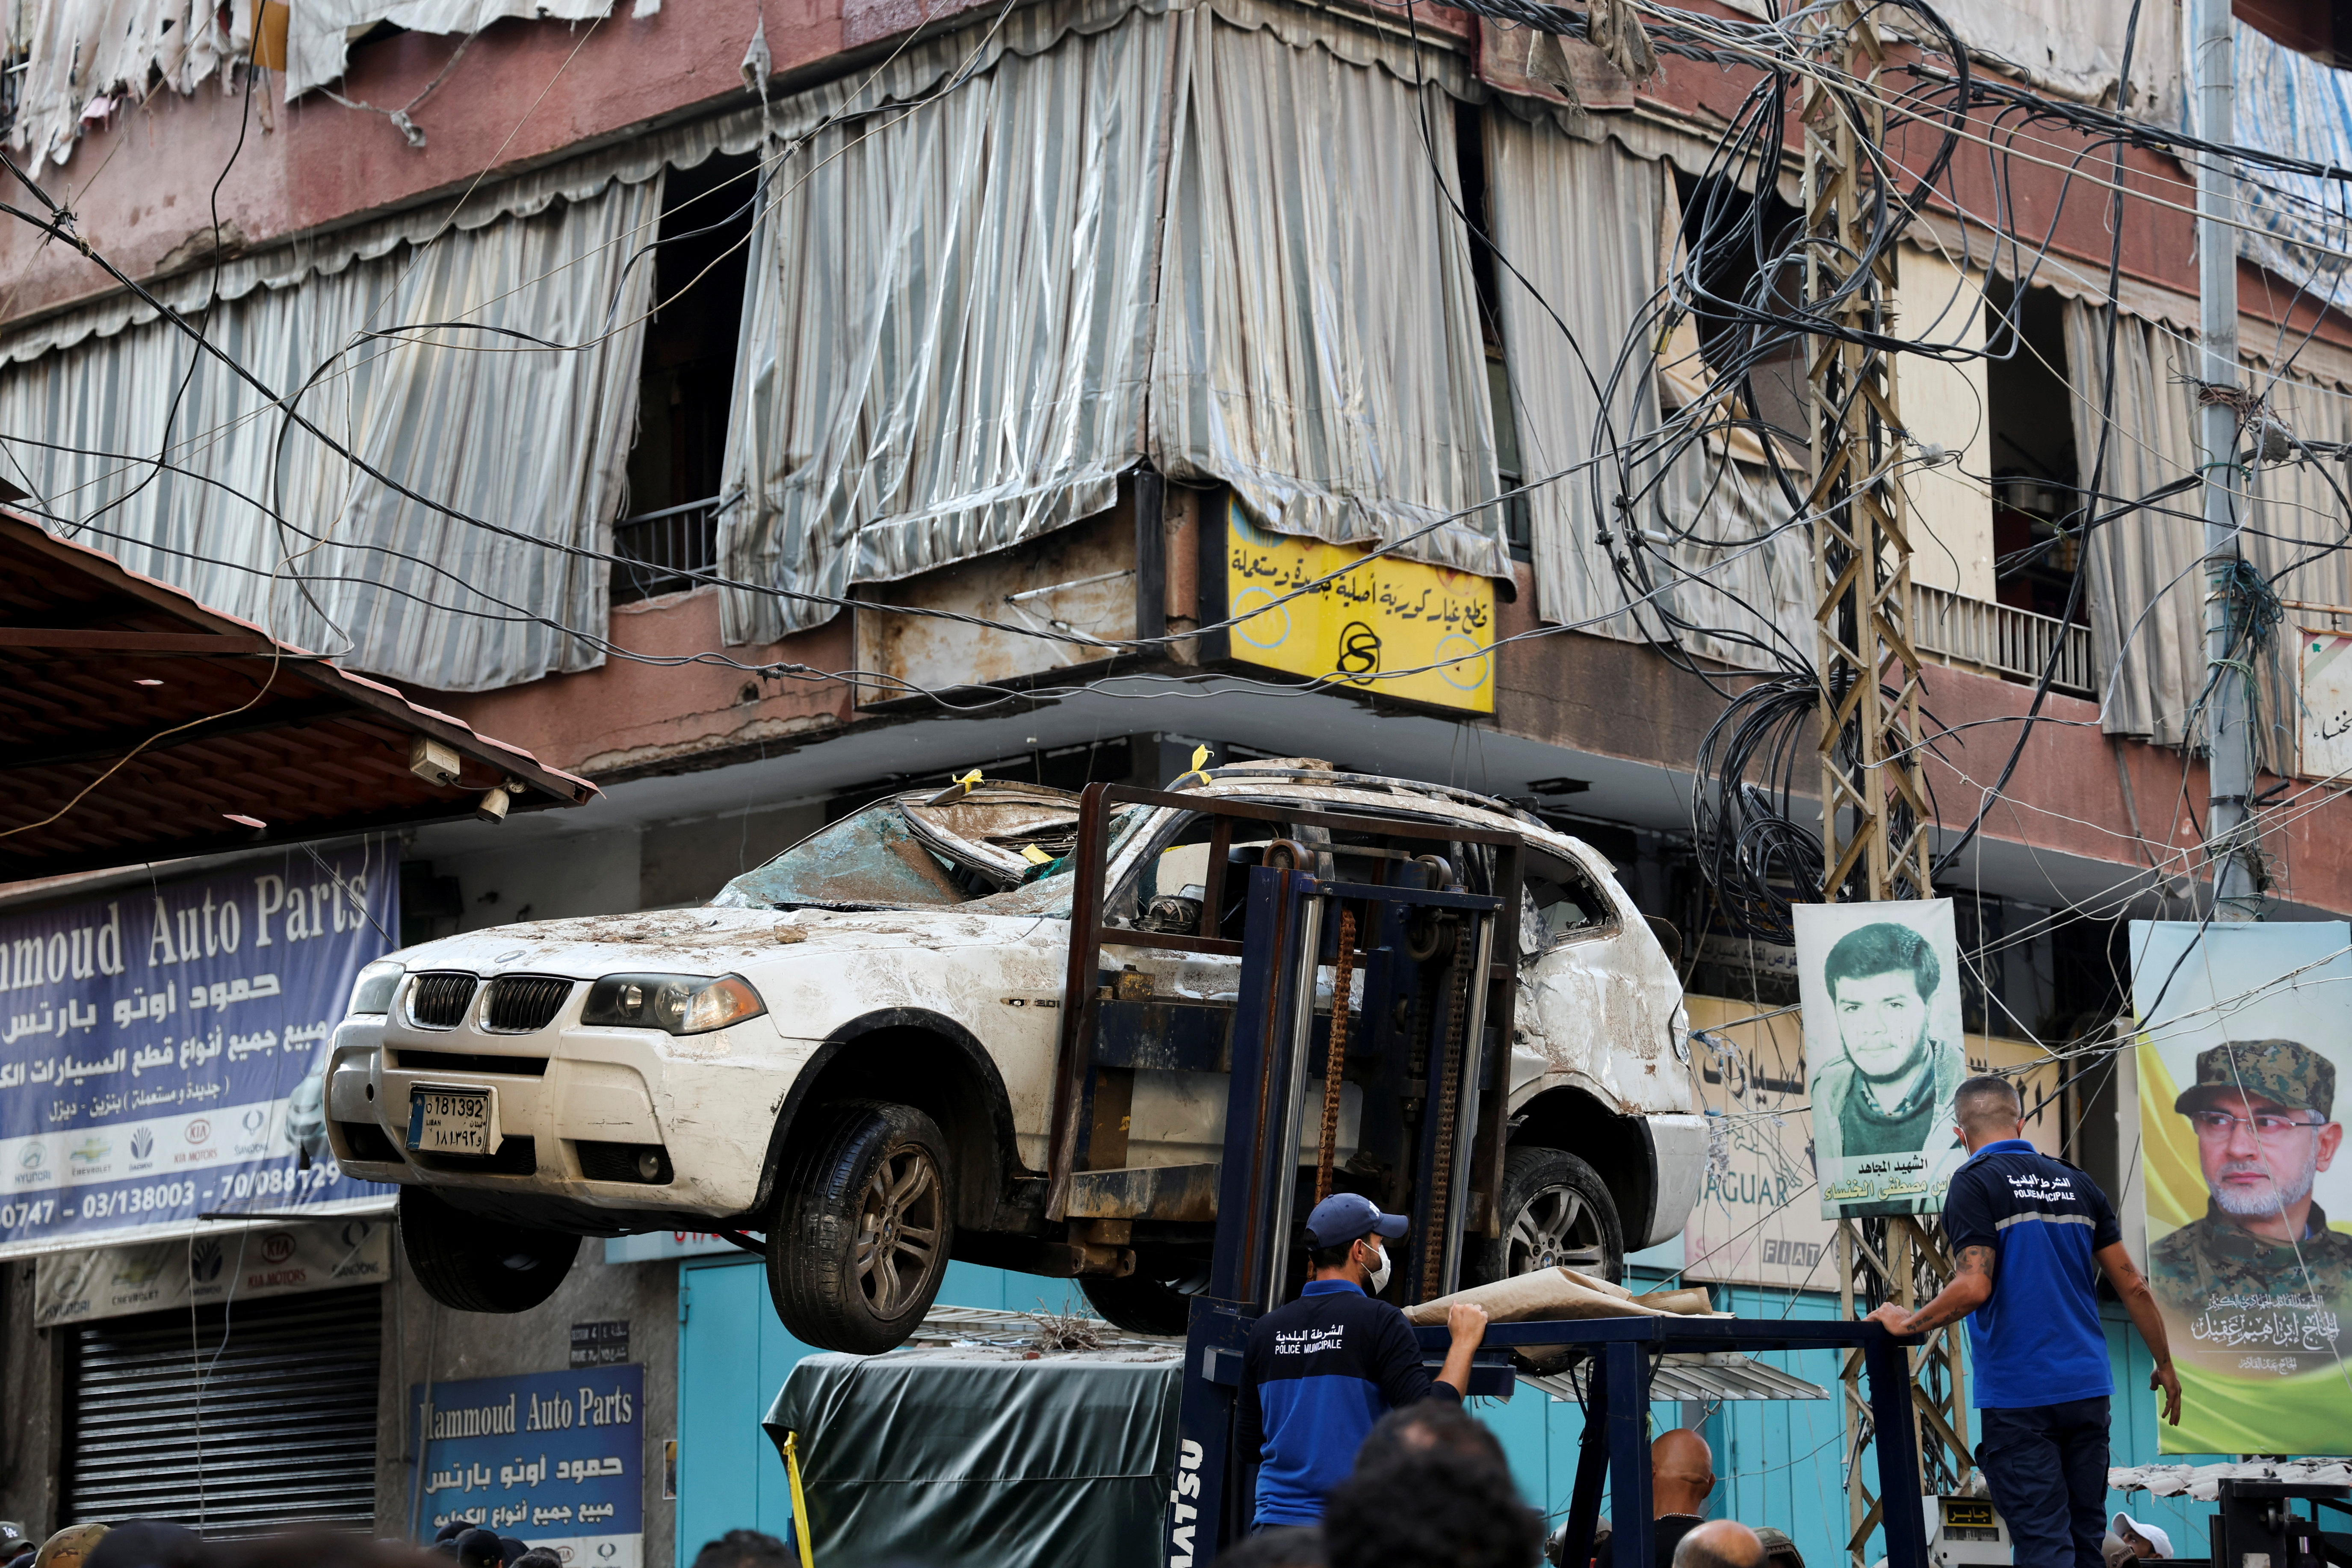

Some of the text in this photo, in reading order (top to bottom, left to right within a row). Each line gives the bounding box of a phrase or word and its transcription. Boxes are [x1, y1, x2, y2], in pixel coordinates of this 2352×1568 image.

[1336, 573, 1375, 607] أصلية
[1380, 584, 1432, 619] كورية
[1427, 598, 1460, 631] غيار
[1462, 598, 1487, 634] قطع
[0, 861, 367, 992] moud Auto Parts
[1, 973, 281, 1045] حمود أوتو بارتس
[179, 1024, 223, 1070] أنواع
[228, 1029, 278, 1063] جميع
[283, 1020, 327, 1053] مبيع
[30, 1047, 127, 1087] السيارات
[131, 1036, 174, 1078] قطع
[49, 1099, 78, 1123] ديزل
[189, 1124, 206, 1138] KIA
[174, 1148, 218, 1164] KIA MOTORS
[1858, 1154, 1928, 1176] الشهيد المجاهد
[14, 1169, 51, 1184] HYUNDAI
[71, 1165, 112, 1176] CHEVROLET
[2007, 1174, 2038, 1187] البلدية
[83, 1181, 195, 1219] 03/138003
[1696, 1171, 1790, 1208] JAGUAR
[1823, 1179, 1874, 1201] الخنساء
[1878, 1176, 1927, 1200] مصطفى
[267, 1240, 289, 1256] KIA
[1765, 1242, 1818, 1267] FIAT
[248, 1268, 306, 1289] KIA MOTORS
[112, 1289, 160, 1305] CHEVROLET
[1276, 1324, 1344, 1344] الشرطة البلدية
[1275, 1339, 1342, 1355] POLICE MUNICIPALE
[526, 1391, 572, 1432] Auto
[578, 1385, 632, 1427] Parts
[425, 1453, 623, 1494] حمود أوتو بارتس
[491, 1499, 528, 1530] أنواع
[532, 1505, 573, 1527] جميع
[578, 1502, 614, 1523] مبيع
[2, 1526, 18, 1538] LA
